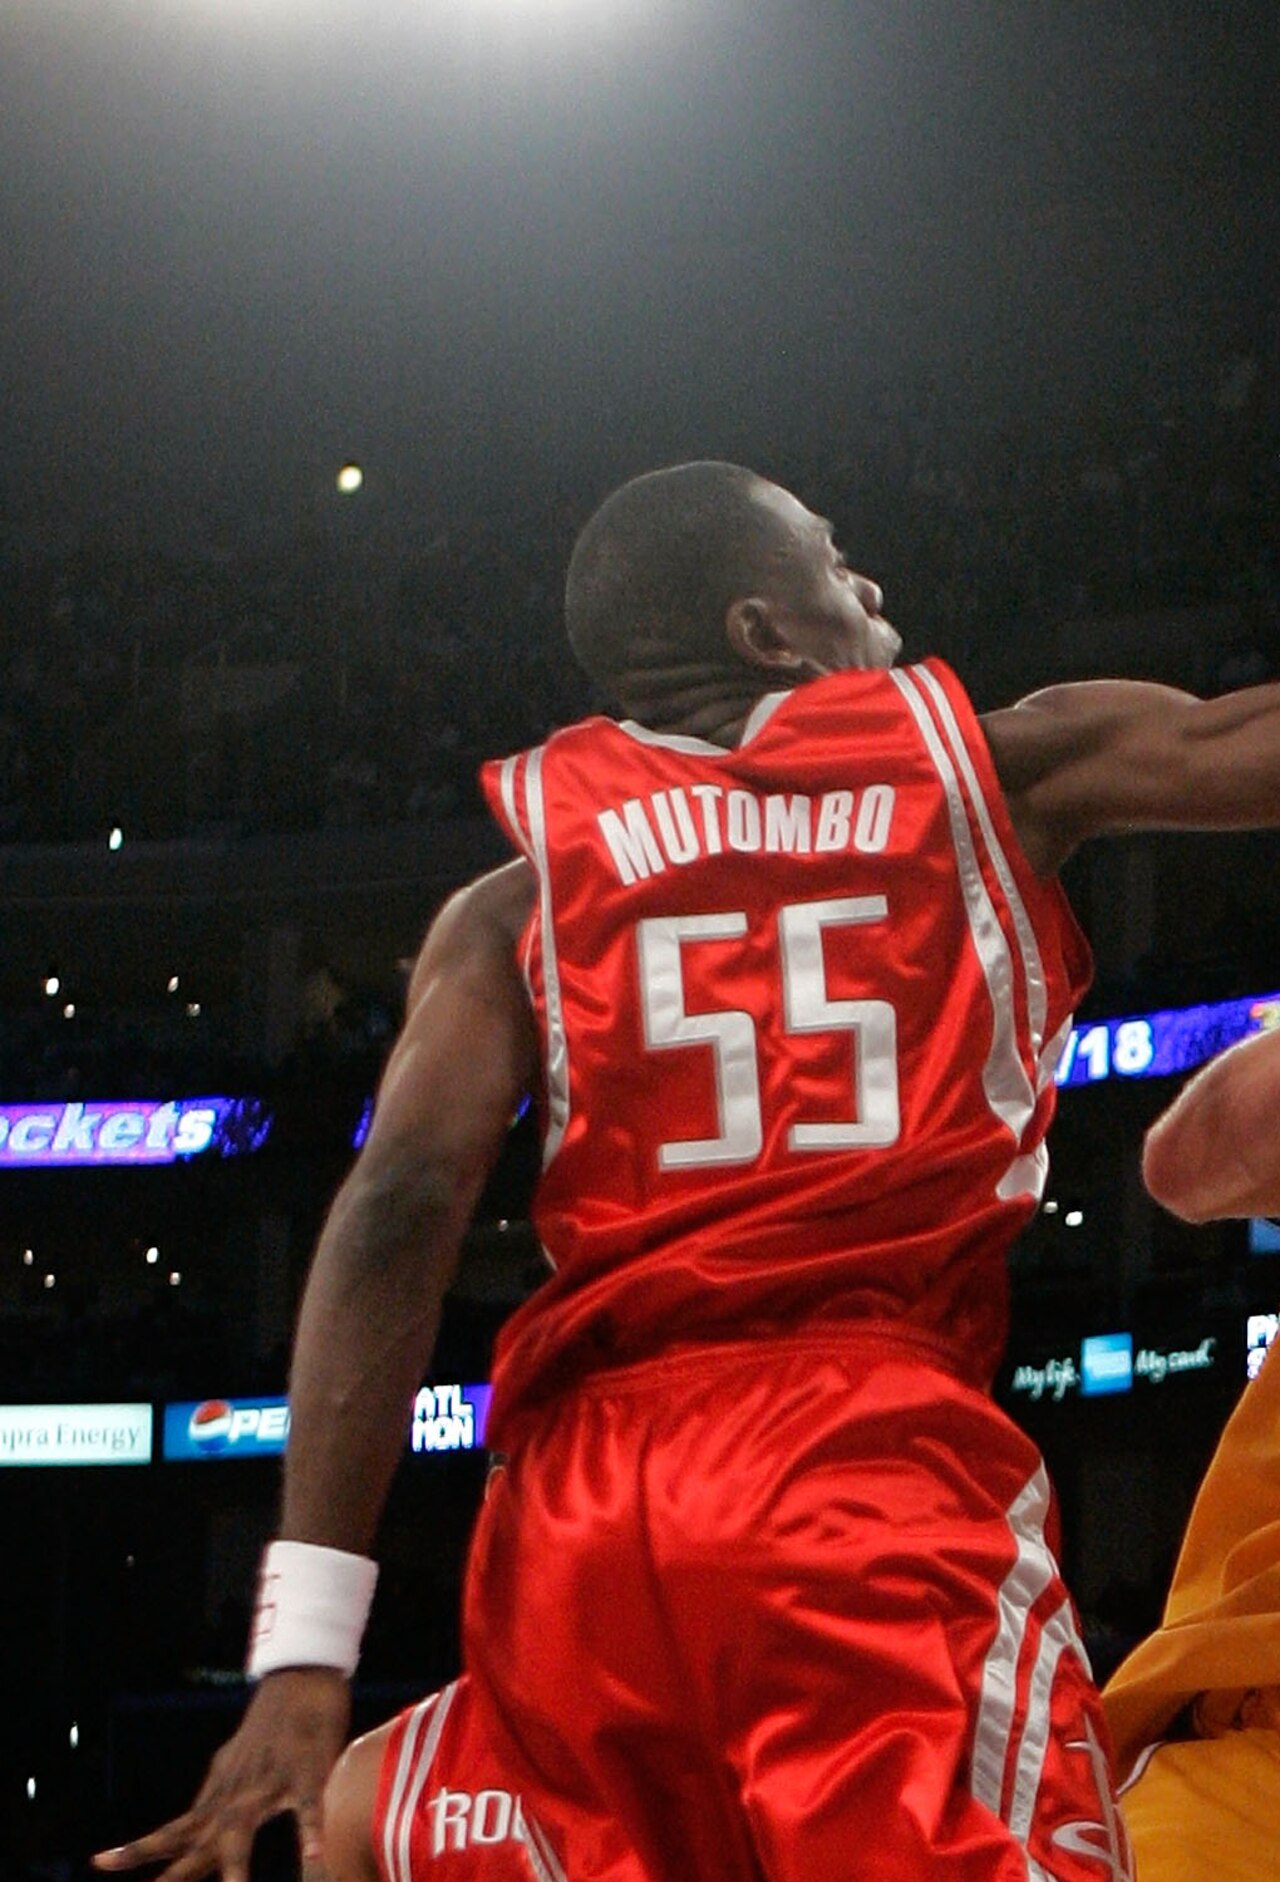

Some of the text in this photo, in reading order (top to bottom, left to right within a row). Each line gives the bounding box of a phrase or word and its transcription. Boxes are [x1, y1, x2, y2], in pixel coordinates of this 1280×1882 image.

[597, 784, 895, 887] MUTOMBO
[637, 895, 900, 1171] 55
[414, 1385, 473, 1416] ATL
[56, 1422, 141, 1452] Energy
